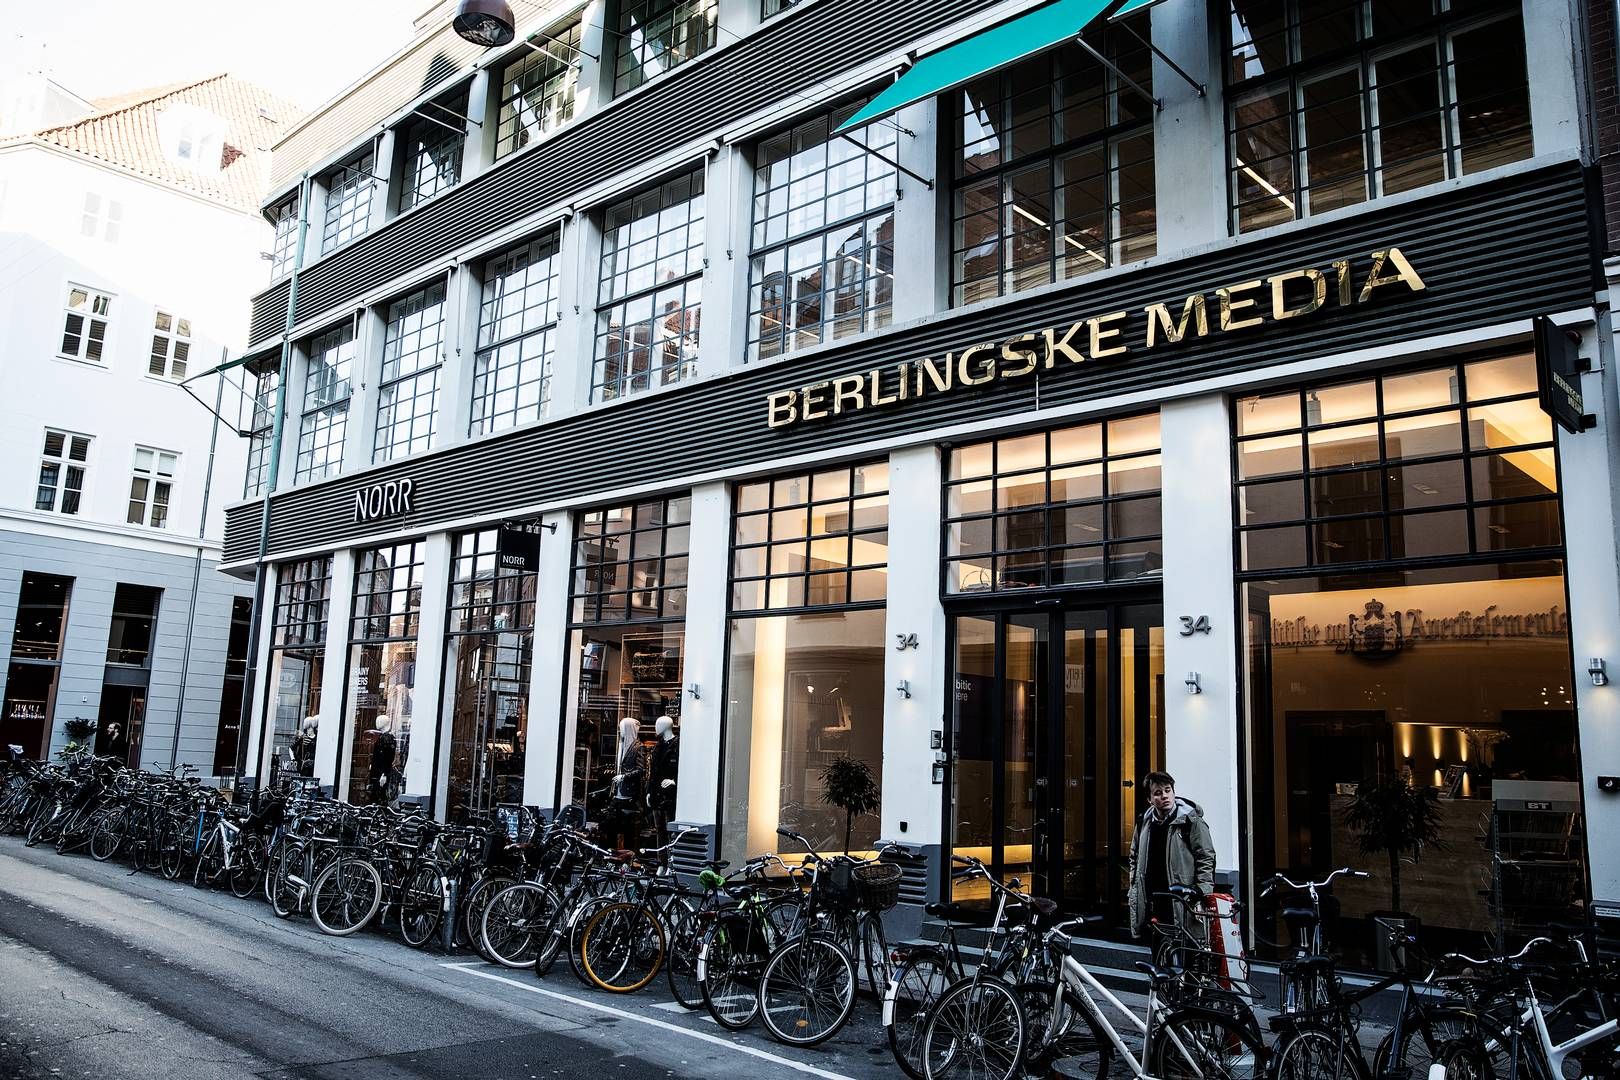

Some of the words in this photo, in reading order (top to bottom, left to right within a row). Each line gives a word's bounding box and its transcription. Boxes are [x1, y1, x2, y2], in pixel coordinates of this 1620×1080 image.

[767, 311, 1127, 428] BERLINGSKE
[1144, 247, 1426, 348] MEDIA
[354, 478, 412, 522] NORR
[502, 555, 526, 566] NORR
[1179, 615, 1212, 637] 34
[895, 633, 920, 651] 34
